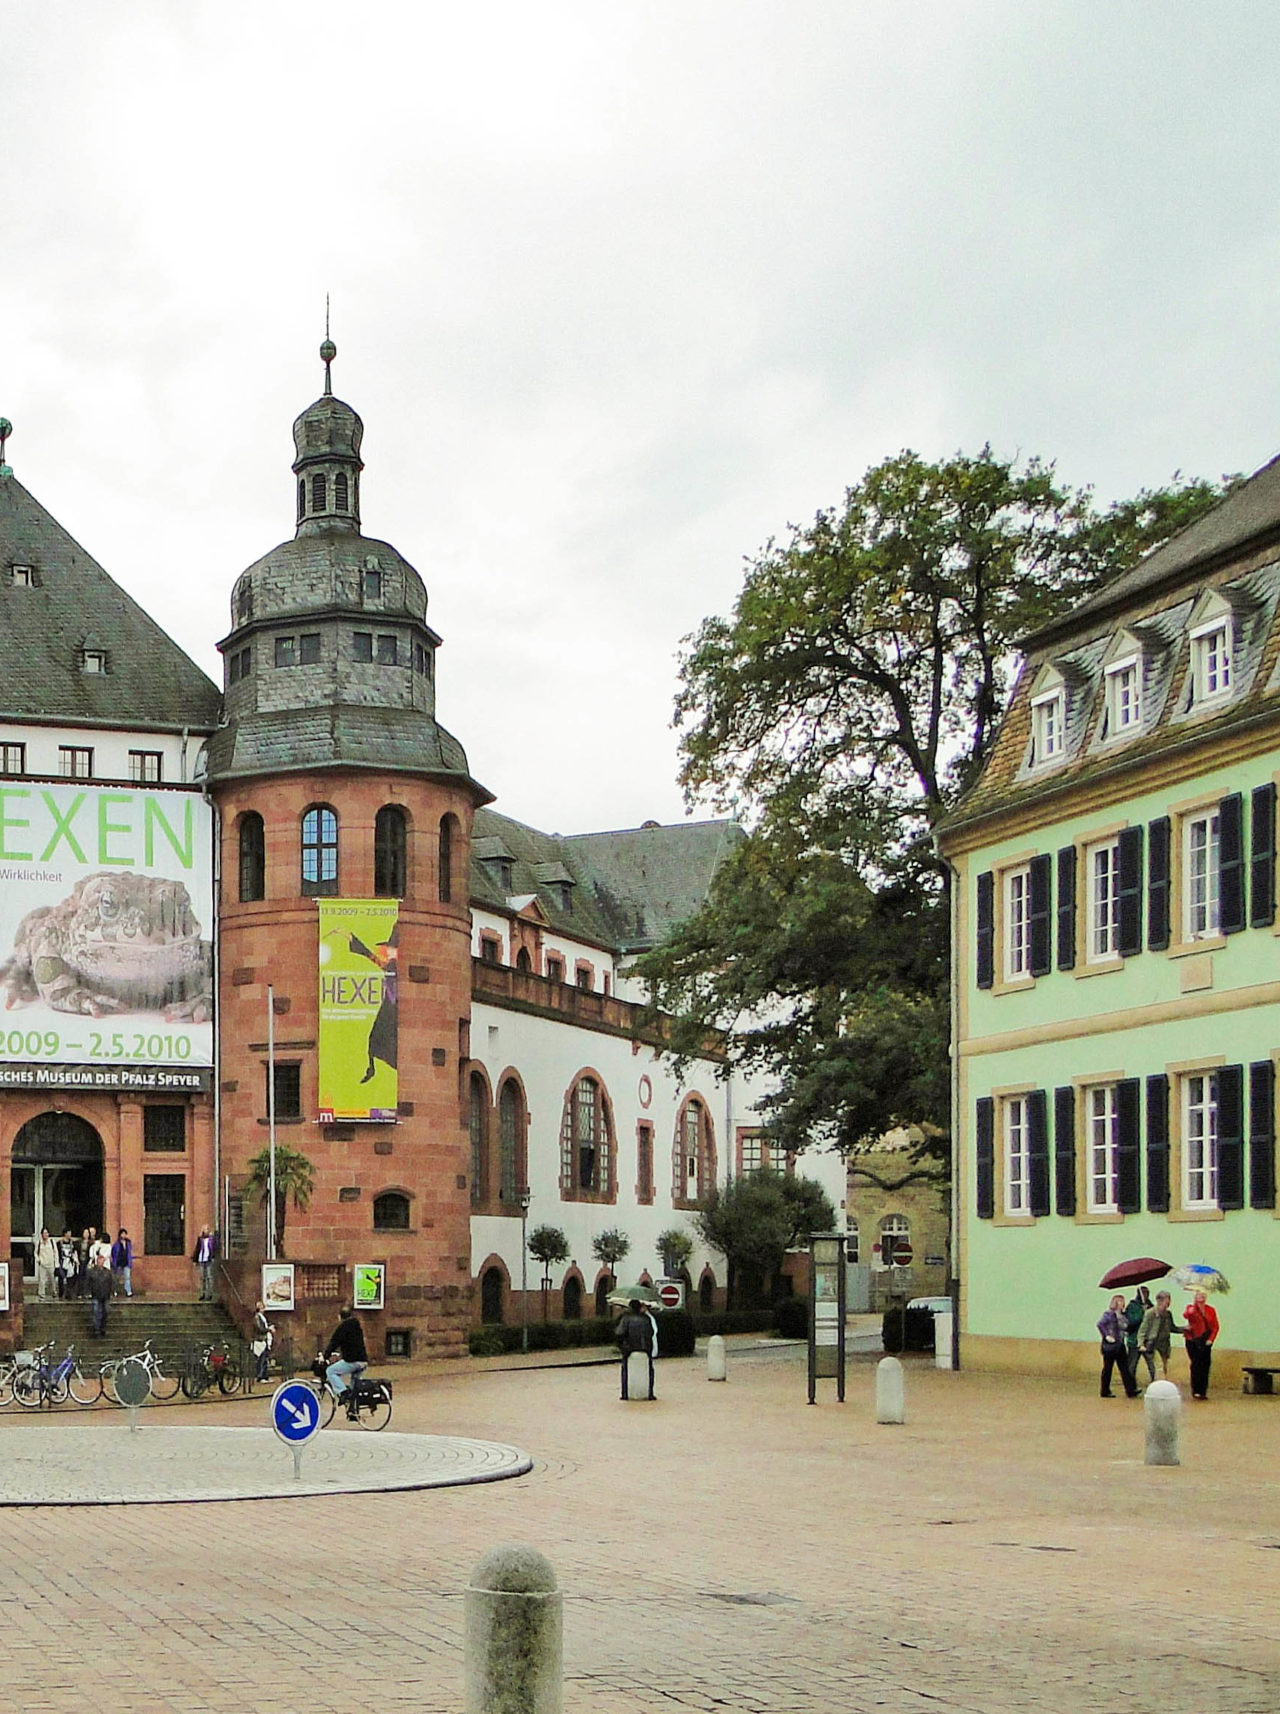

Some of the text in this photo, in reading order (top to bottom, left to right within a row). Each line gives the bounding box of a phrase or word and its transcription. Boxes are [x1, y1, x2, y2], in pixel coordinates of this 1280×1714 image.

[89, 1032, 192, 1059] 2.5.2010
[36, 1070, 93, 1084] MUSEUM
[95, 1073, 119, 1084] DER
[121, 1071, 156, 1085] PFALZ
[157, 1072, 200, 1086] SPEYER
